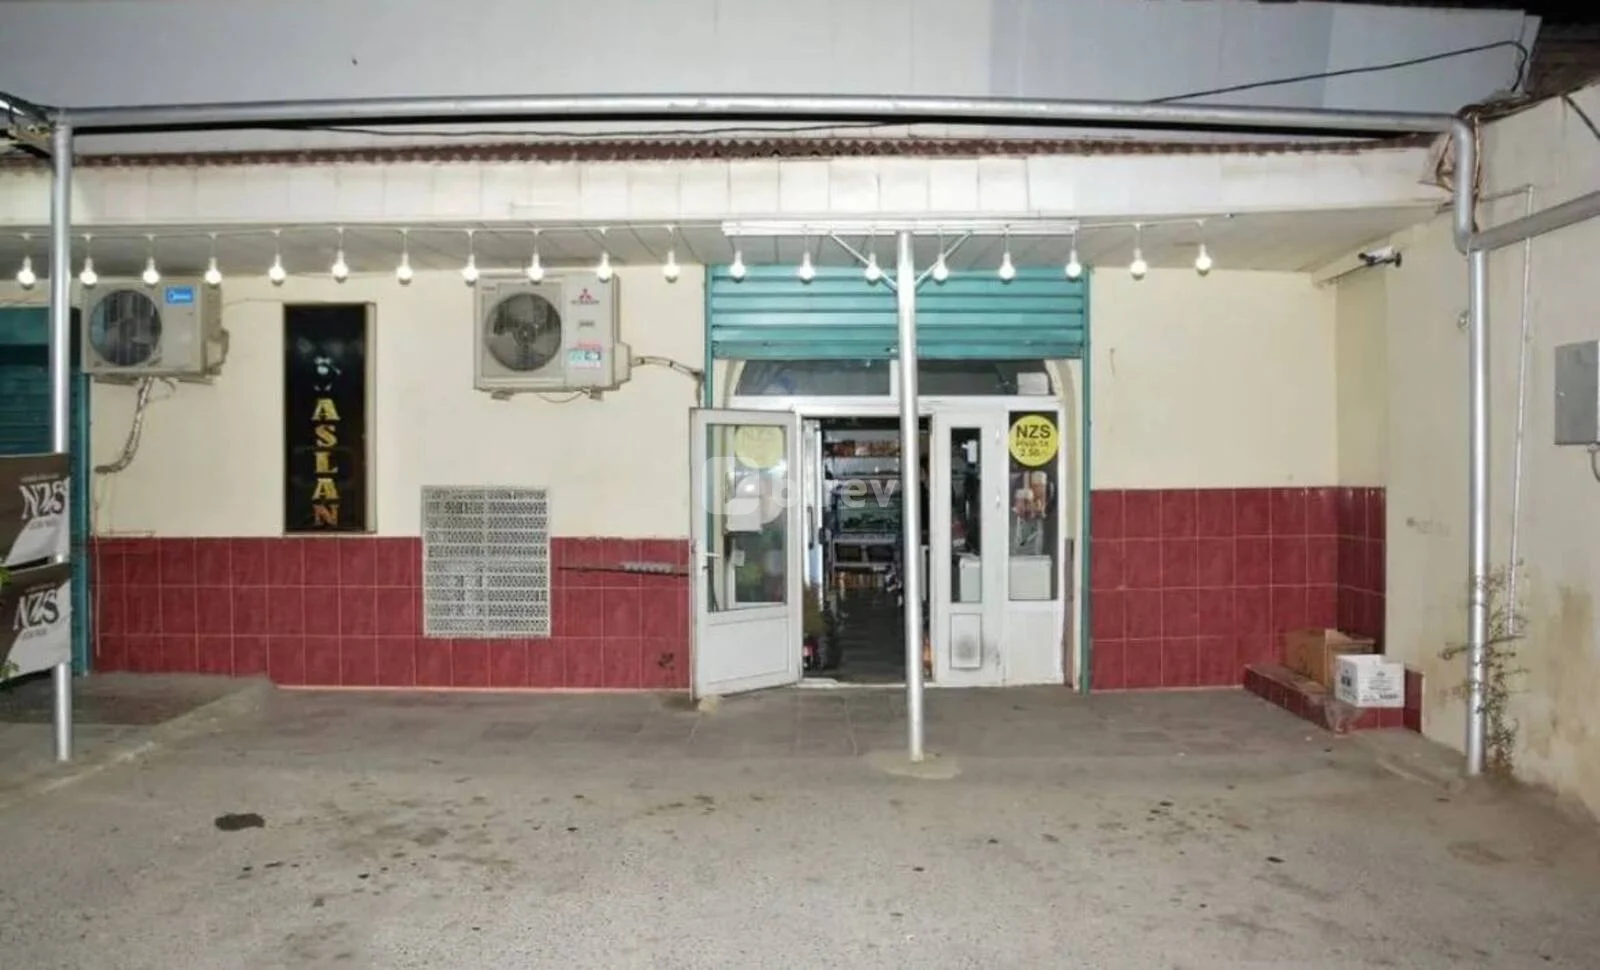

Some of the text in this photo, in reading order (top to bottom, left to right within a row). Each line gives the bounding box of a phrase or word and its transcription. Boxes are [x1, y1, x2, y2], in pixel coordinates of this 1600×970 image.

[1017, 424, 1051, 439] NZS
[311, 398, 341, 526] ASLAN
[19, 481, 65, 520] NZS
[13, 589, 59, 631] NZS
